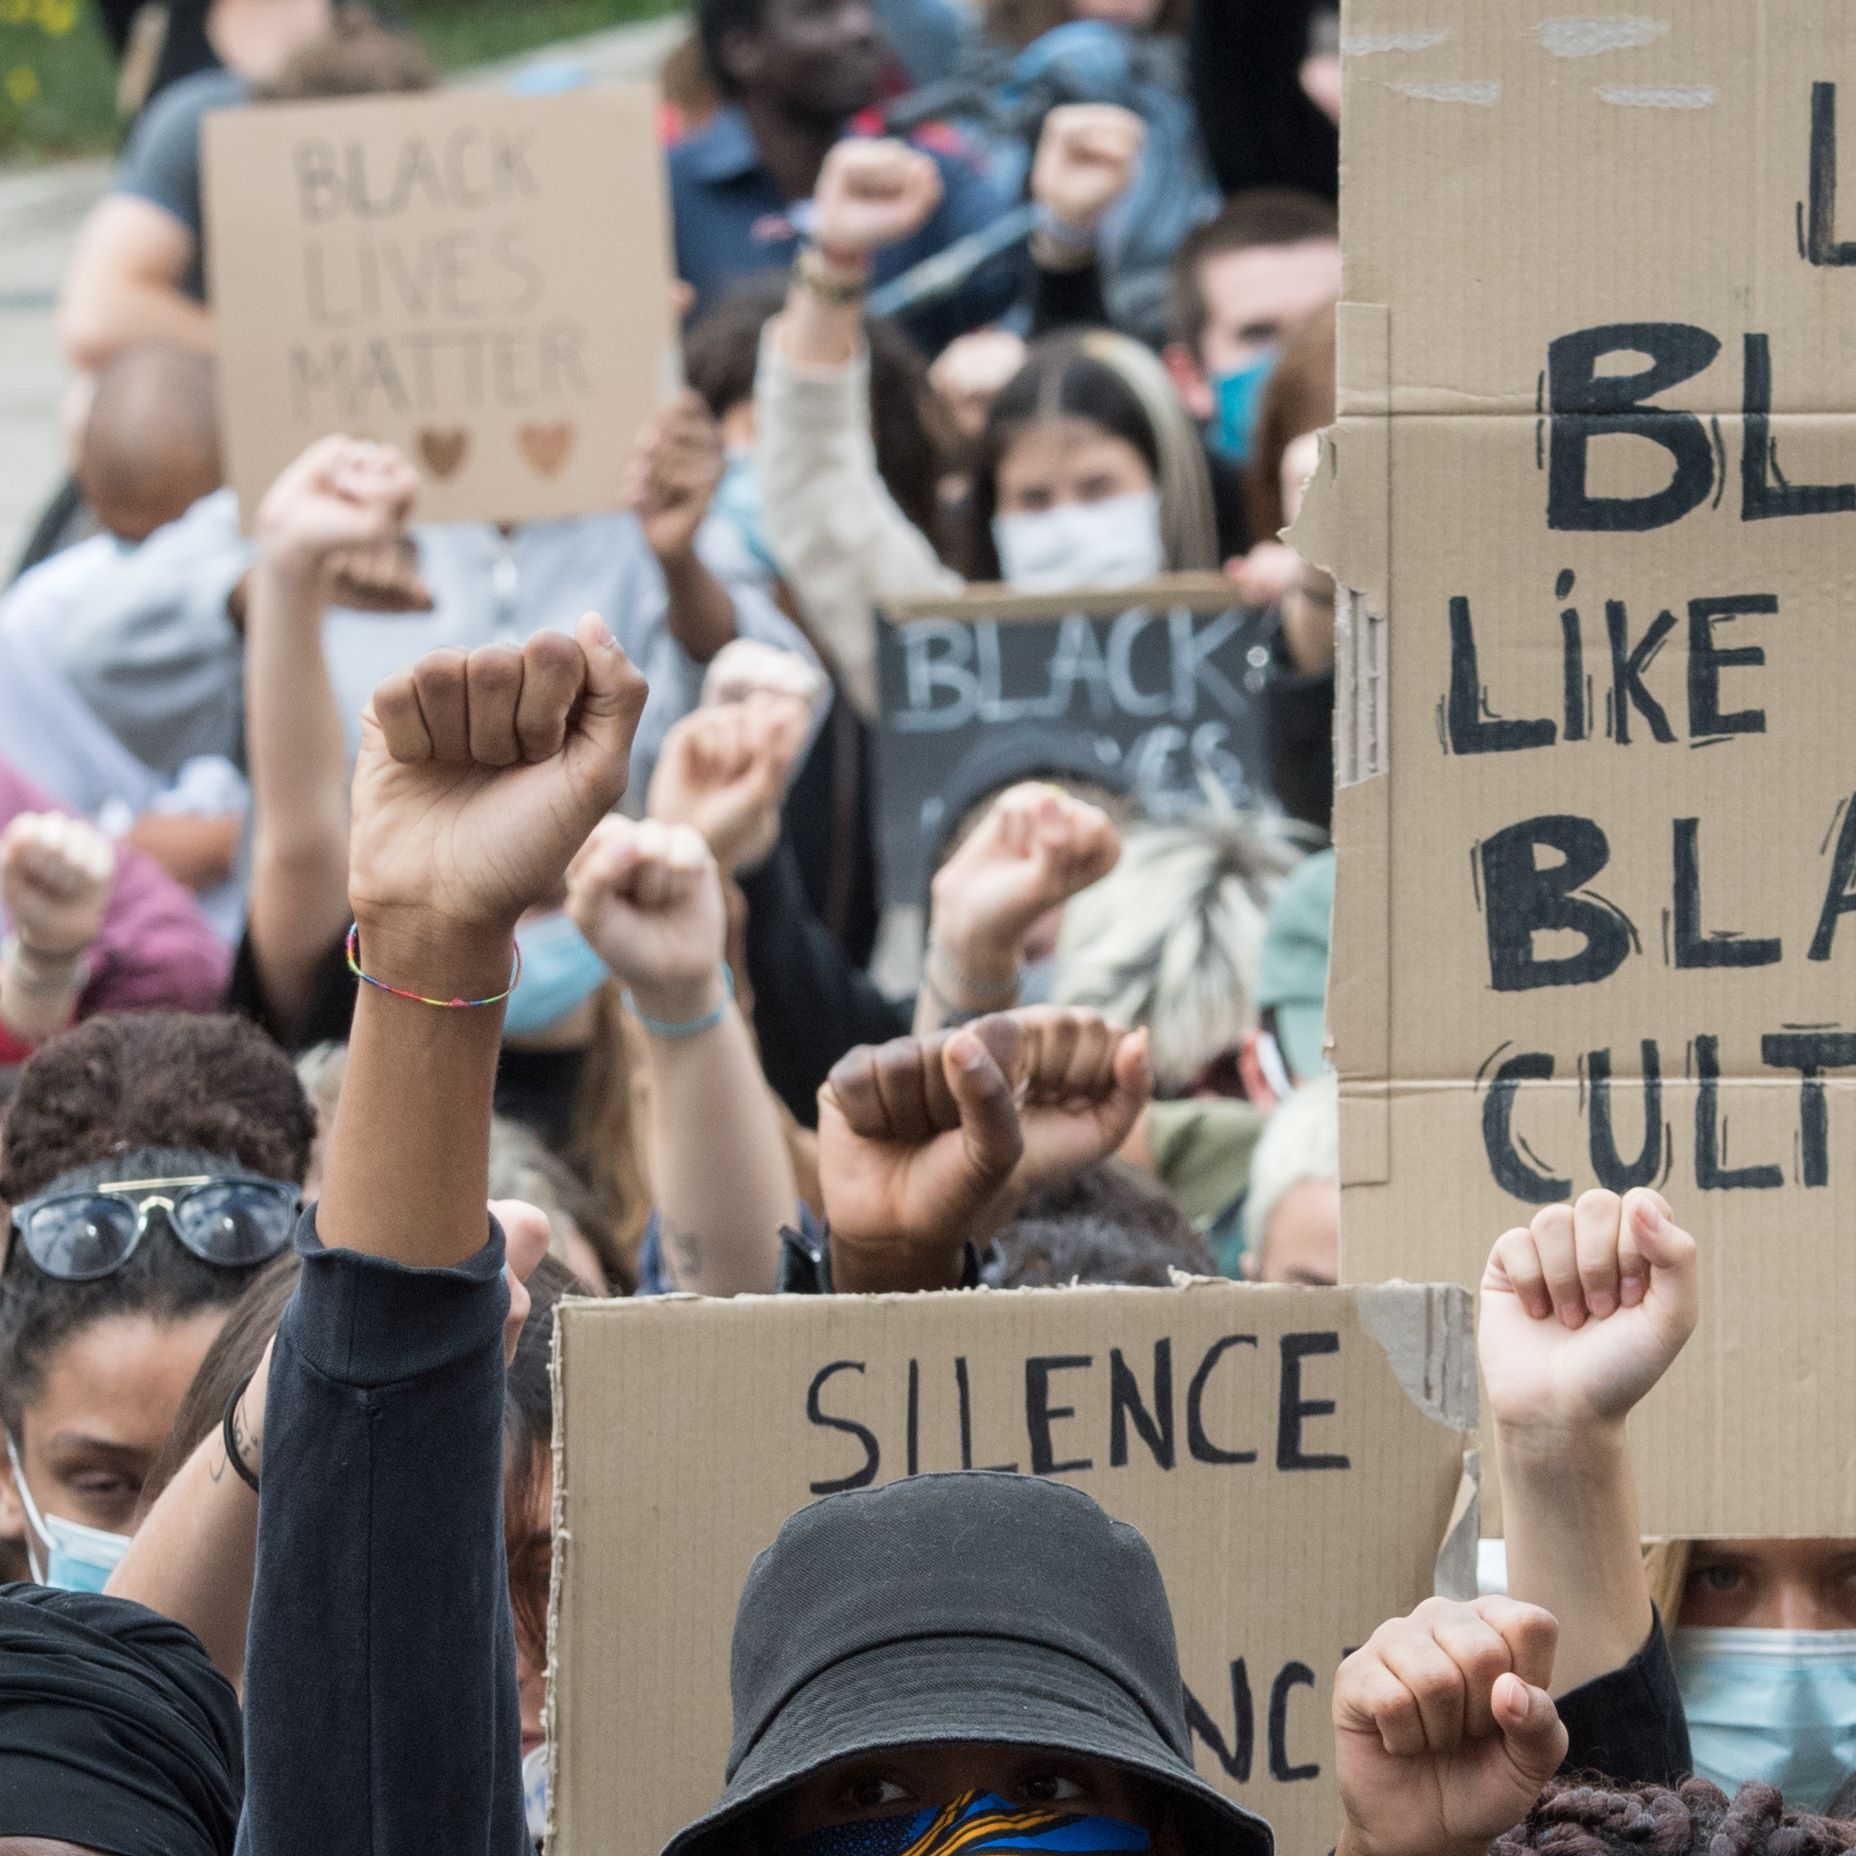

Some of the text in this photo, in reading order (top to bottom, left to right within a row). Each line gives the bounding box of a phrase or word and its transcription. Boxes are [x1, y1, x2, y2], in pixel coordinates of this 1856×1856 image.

[296, 123, 542, 225] BLACK
[302, 222, 547, 328] LIVES
[288, 315, 593, 426] MATTER
[892, 606, 1252, 732] BLACK
[804, 1331, 1351, 1496] SILENCE
